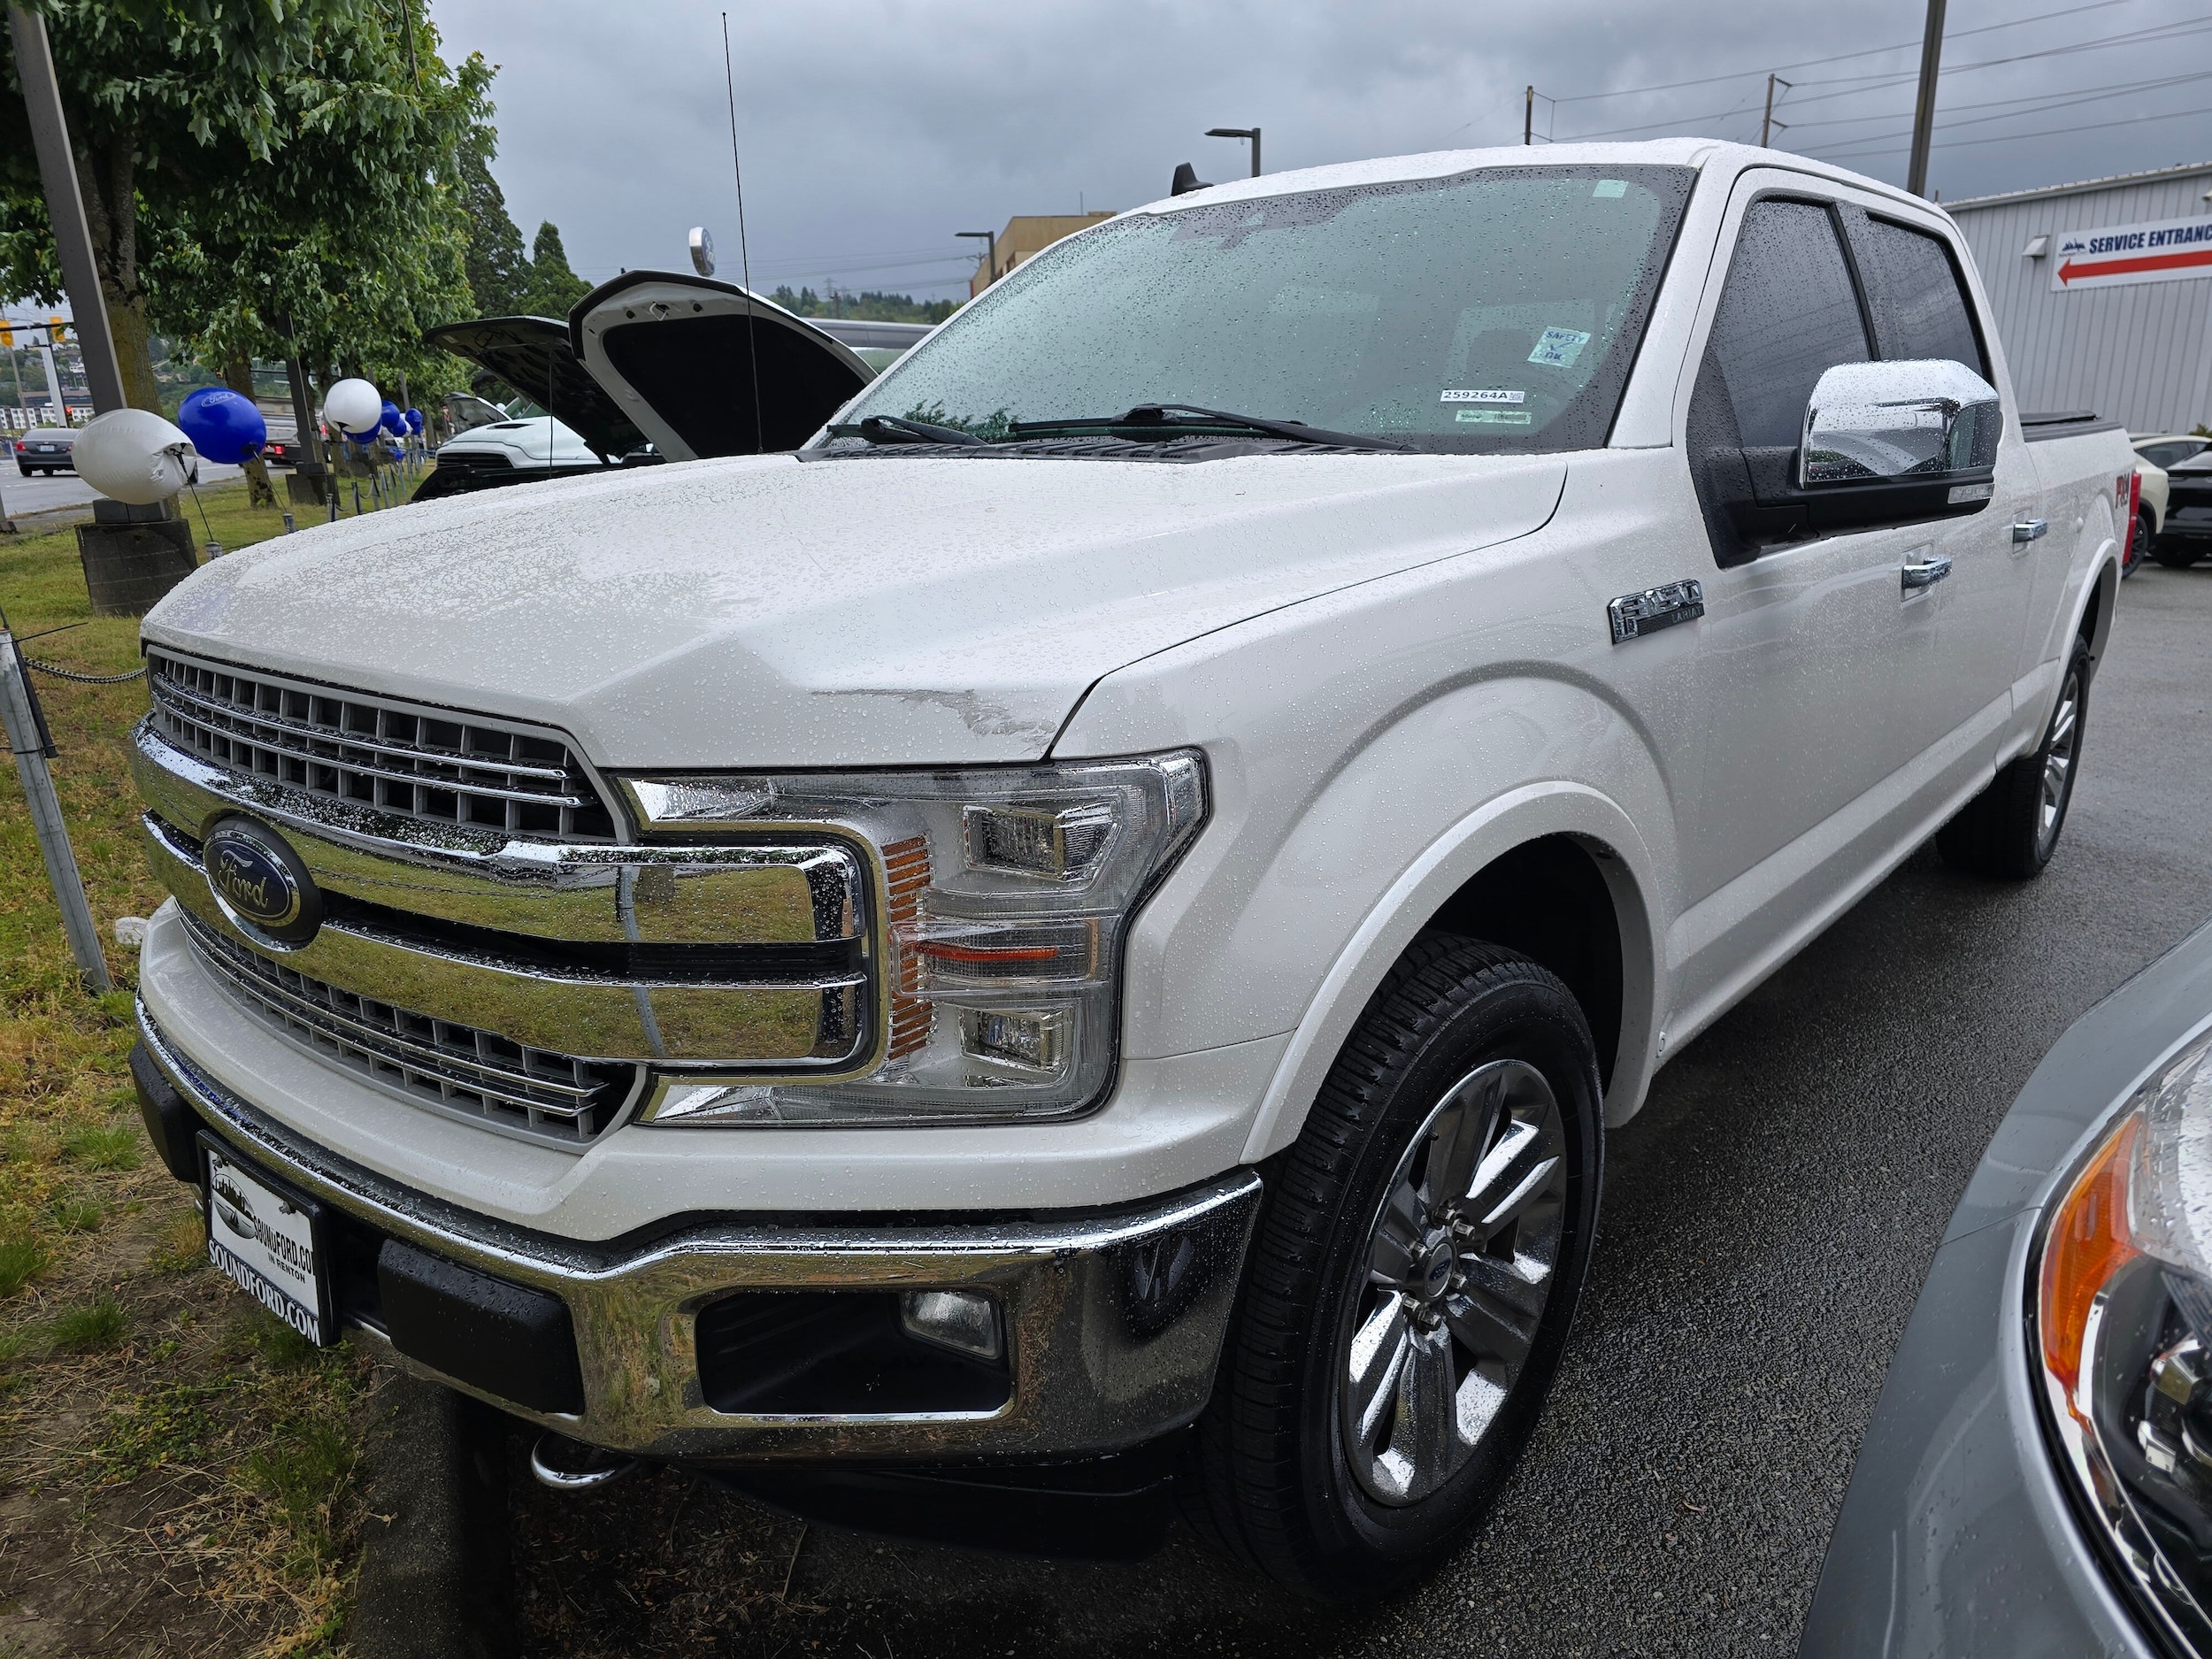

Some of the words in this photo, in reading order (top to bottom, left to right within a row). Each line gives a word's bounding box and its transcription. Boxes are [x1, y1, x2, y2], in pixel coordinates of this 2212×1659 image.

[2089, 232, 2146, 254] SERVICE
[1546, 331, 1585, 343] SAFETY
[1545, 351, 1562, 360] OK
[1671, 605, 1702, 624] LARIAT
[218, 849, 269, 909] Ford
[268, 1252, 275, 1265] IN
[276, 1257, 306, 1284] RENTON
[209, 1239, 321, 1348] SOUNDFORD.COM
